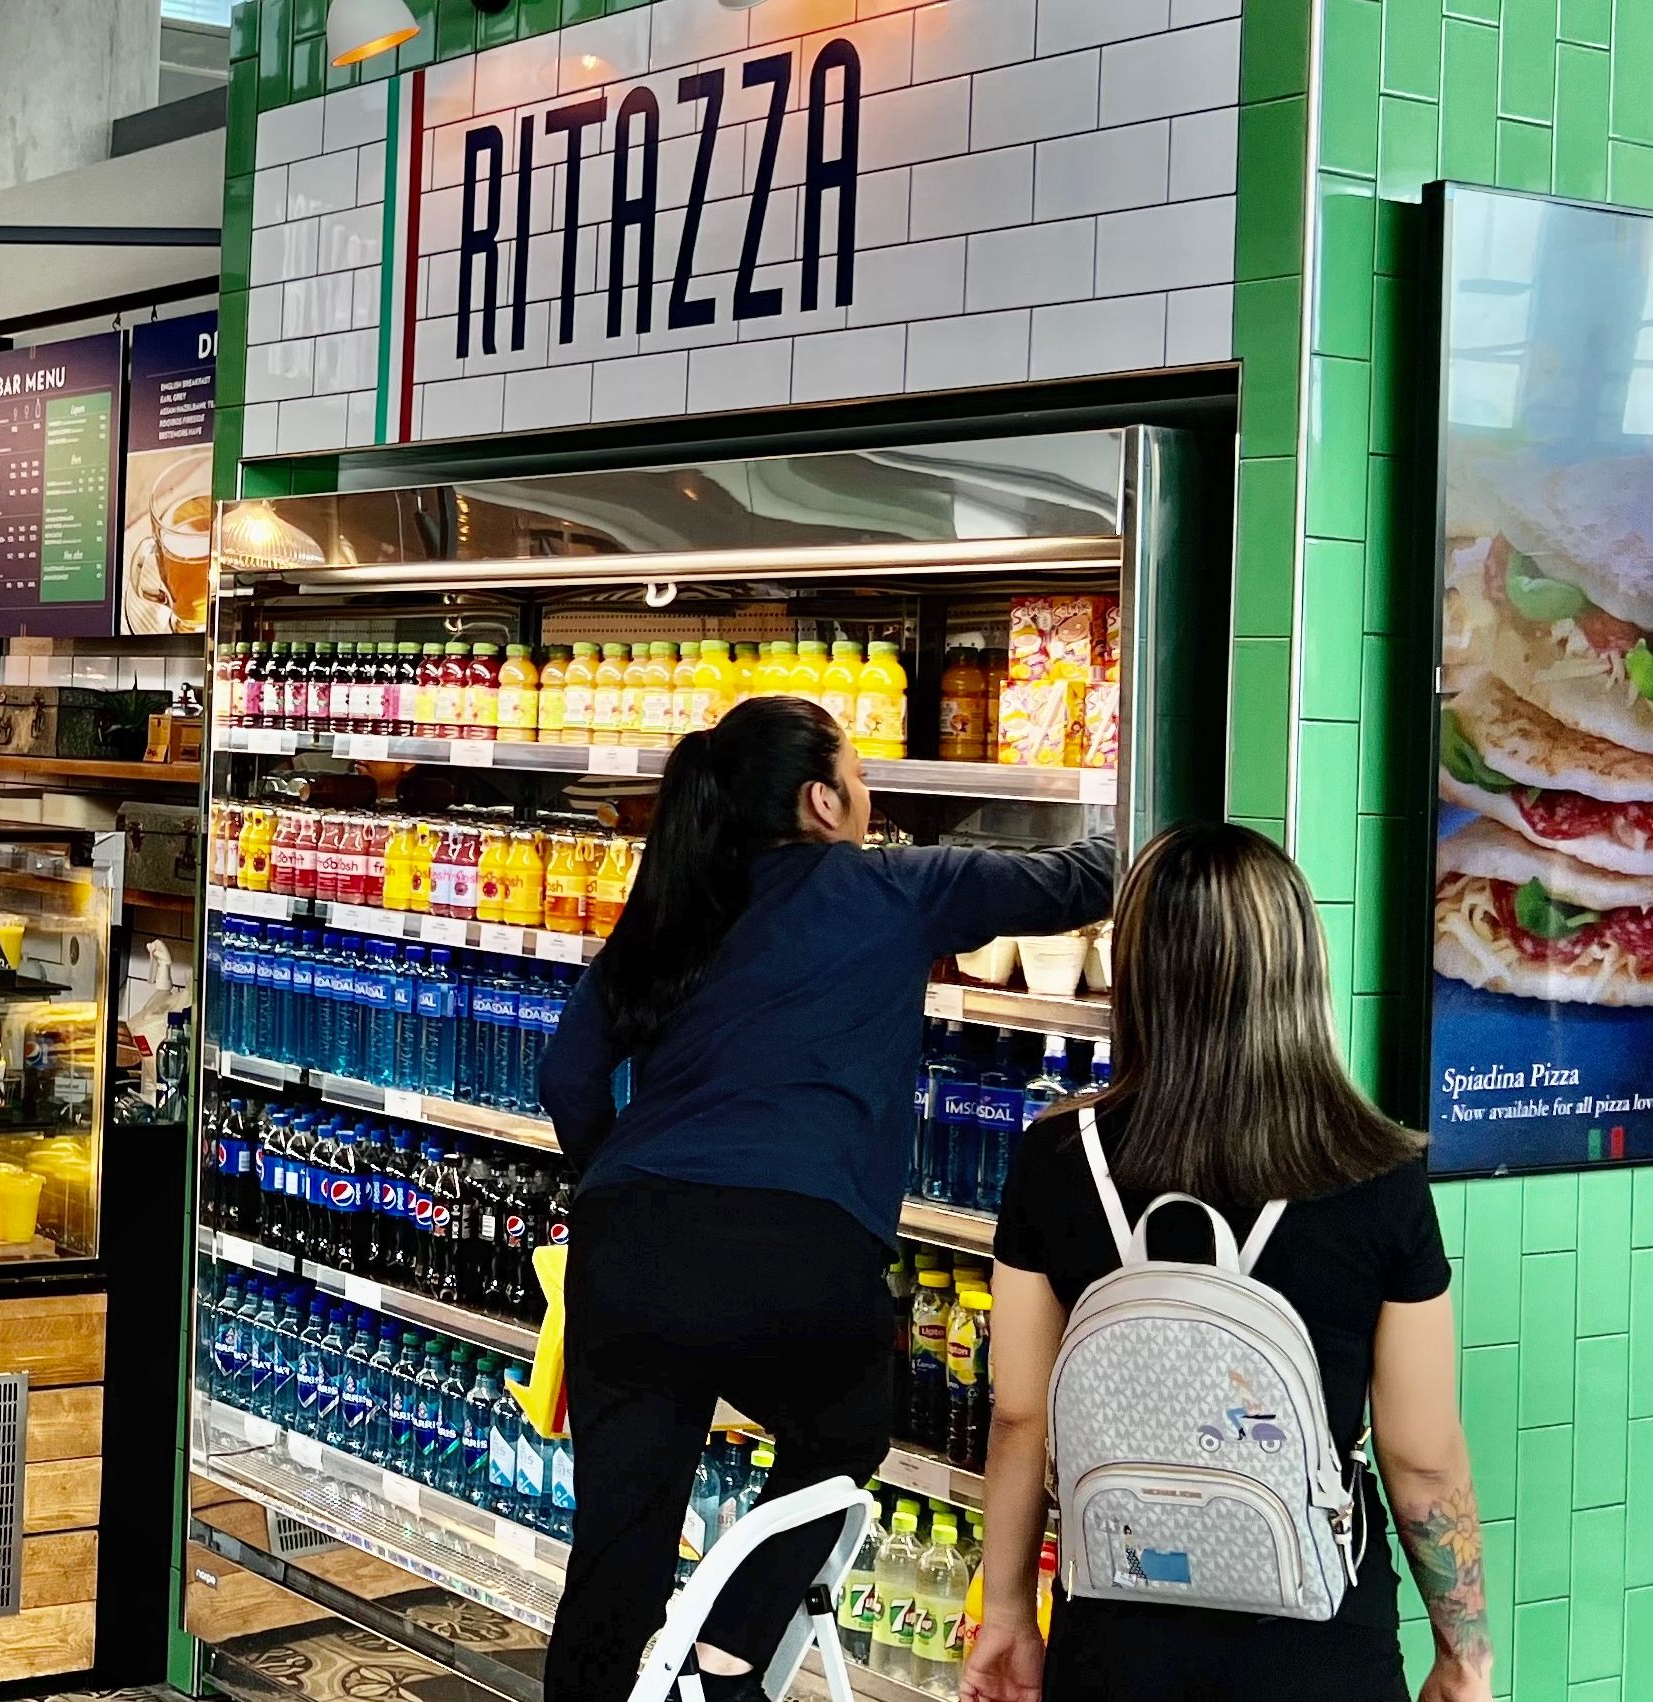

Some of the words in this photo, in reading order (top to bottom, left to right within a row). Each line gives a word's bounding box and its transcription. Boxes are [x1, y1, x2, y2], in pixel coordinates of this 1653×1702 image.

[456, 38, 861, 359] RITAZZA
[25, 366, 66, 392] MENU
[1442, 1064, 1525, 1100] Spiadina
[1530, 1062, 1580, 1088] Pizza
[1451, 1103, 1485, 1122] Now
[1489, 1098, 1550, 1120] available
[1553, 1097, 1571, 1116] for
[1576, 1096, 1592, 1115] all
[1595, 1094, 1631, 1119] pizza
